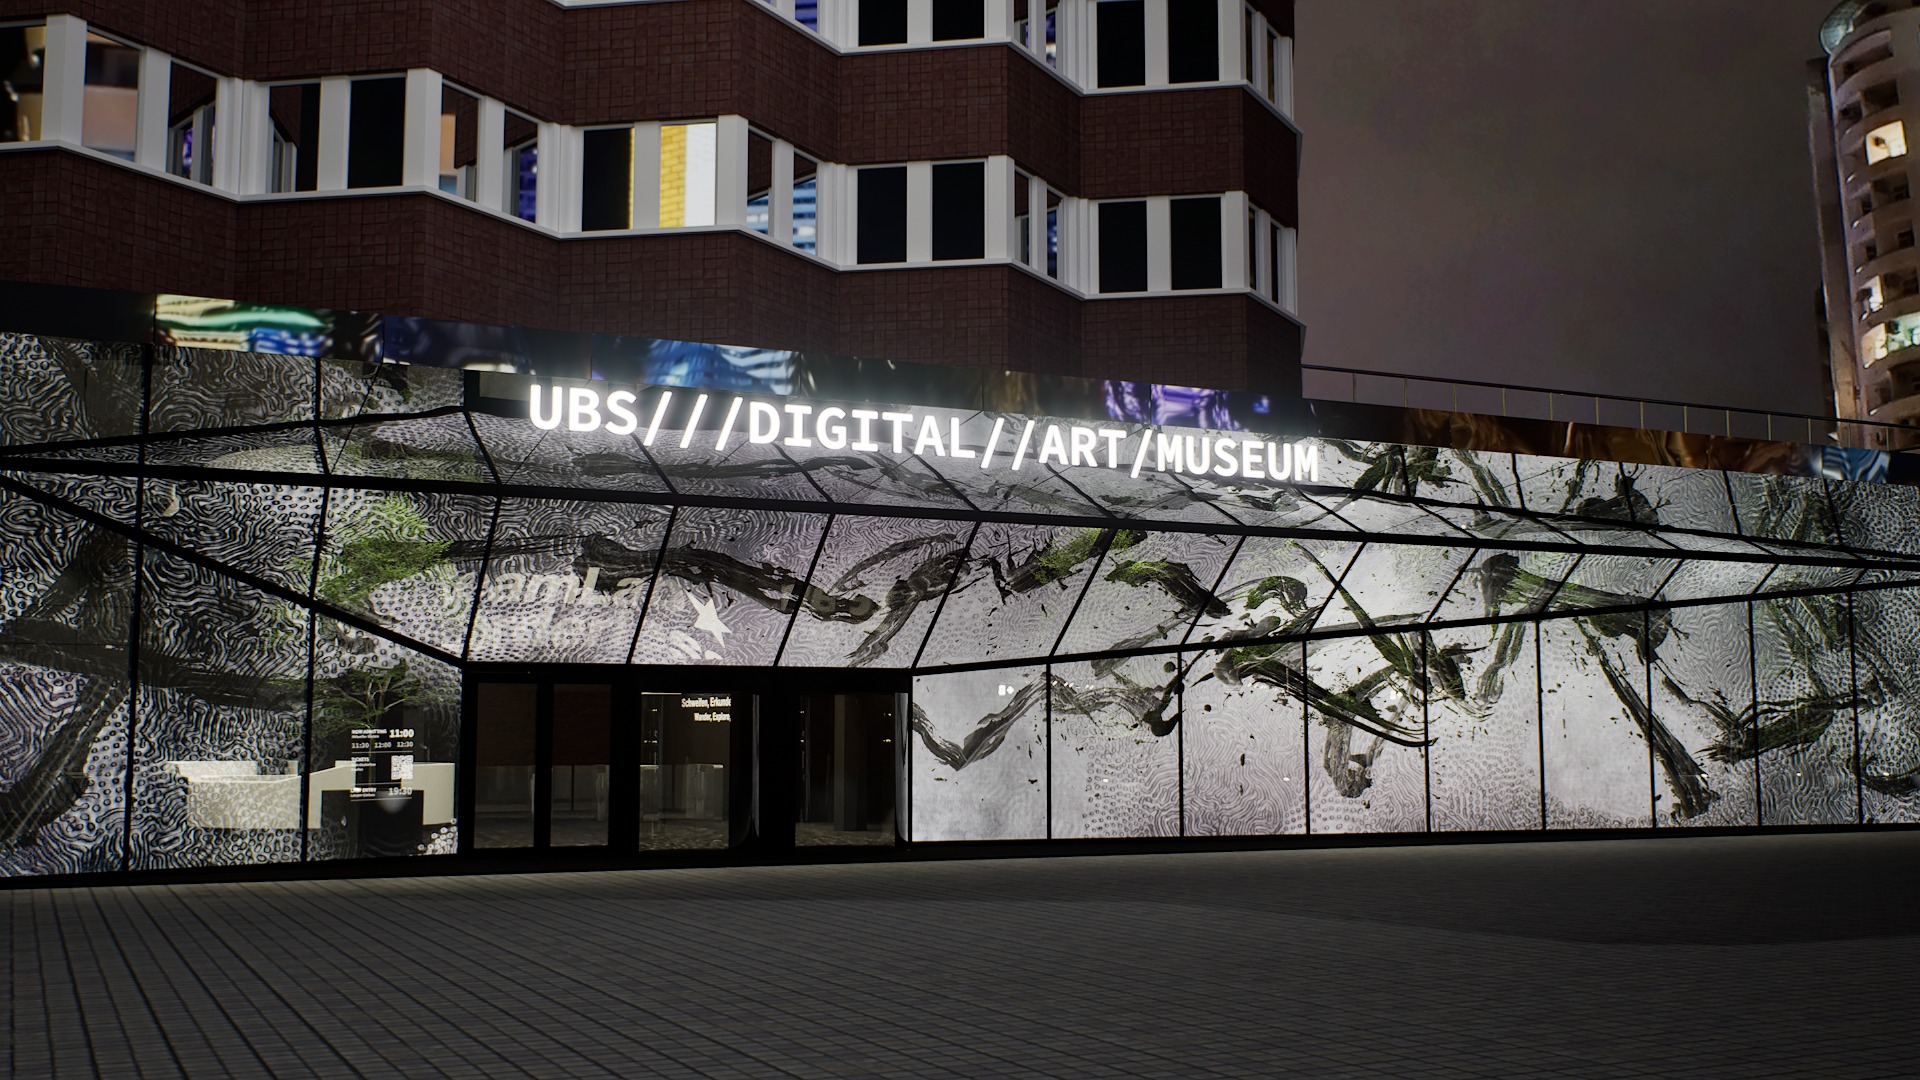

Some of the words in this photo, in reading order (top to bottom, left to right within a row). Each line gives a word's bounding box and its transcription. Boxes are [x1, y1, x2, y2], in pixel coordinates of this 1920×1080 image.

[389, 728, 414, 738] 11:00
[374, 741, 392, 749] 12:00
[388, 787, 413, 796] 19:30
